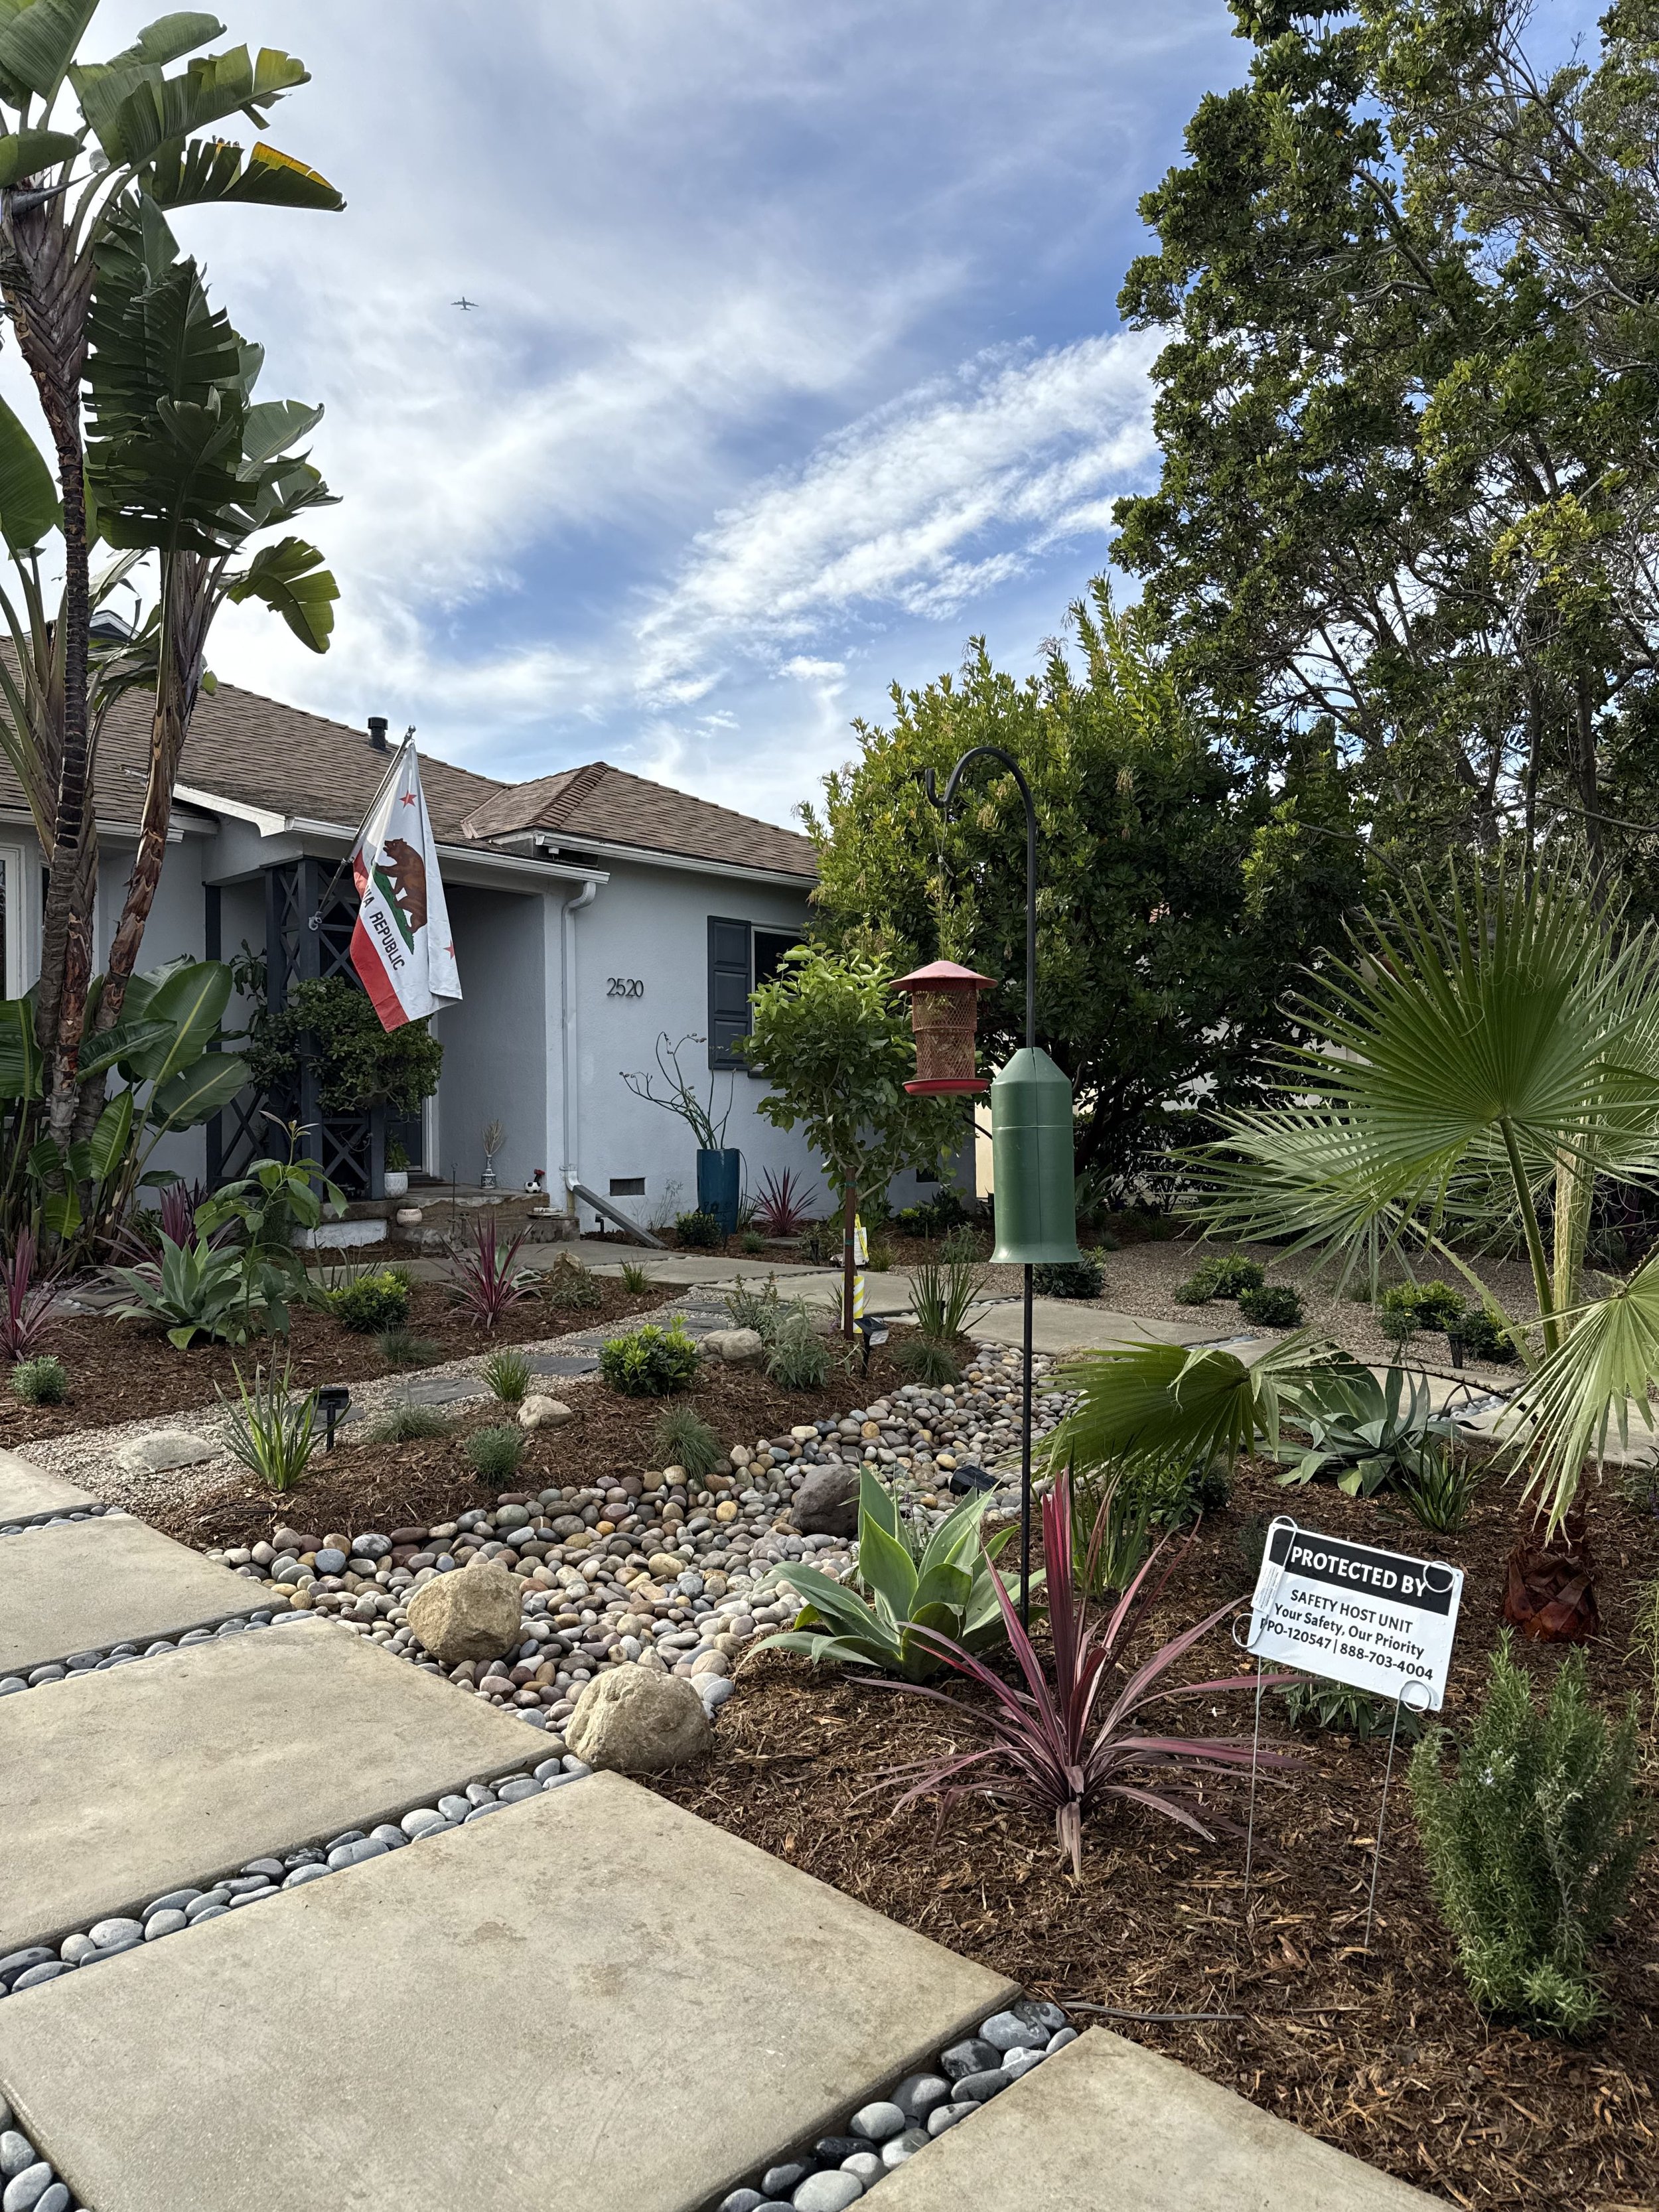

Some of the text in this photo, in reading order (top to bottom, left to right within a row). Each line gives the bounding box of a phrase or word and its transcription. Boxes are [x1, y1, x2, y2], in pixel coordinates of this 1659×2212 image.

[370, 911, 405, 970] REPUBLIC
[607, 978, 644, 997] 2520
[1291, 1546, 1398, 1589] PROTECTED
[1401, 1575, 1427, 1597] BY
[1275, 1603, 1425, 1660] Your Safety, Our Priority
[1290, 1589, 1413, 1633] SAFETY HOST UNIT
[1260, 1617, 1332, 1650] PPO-120547
[1340, 1643, 1433, 1681] 888-703-4004
